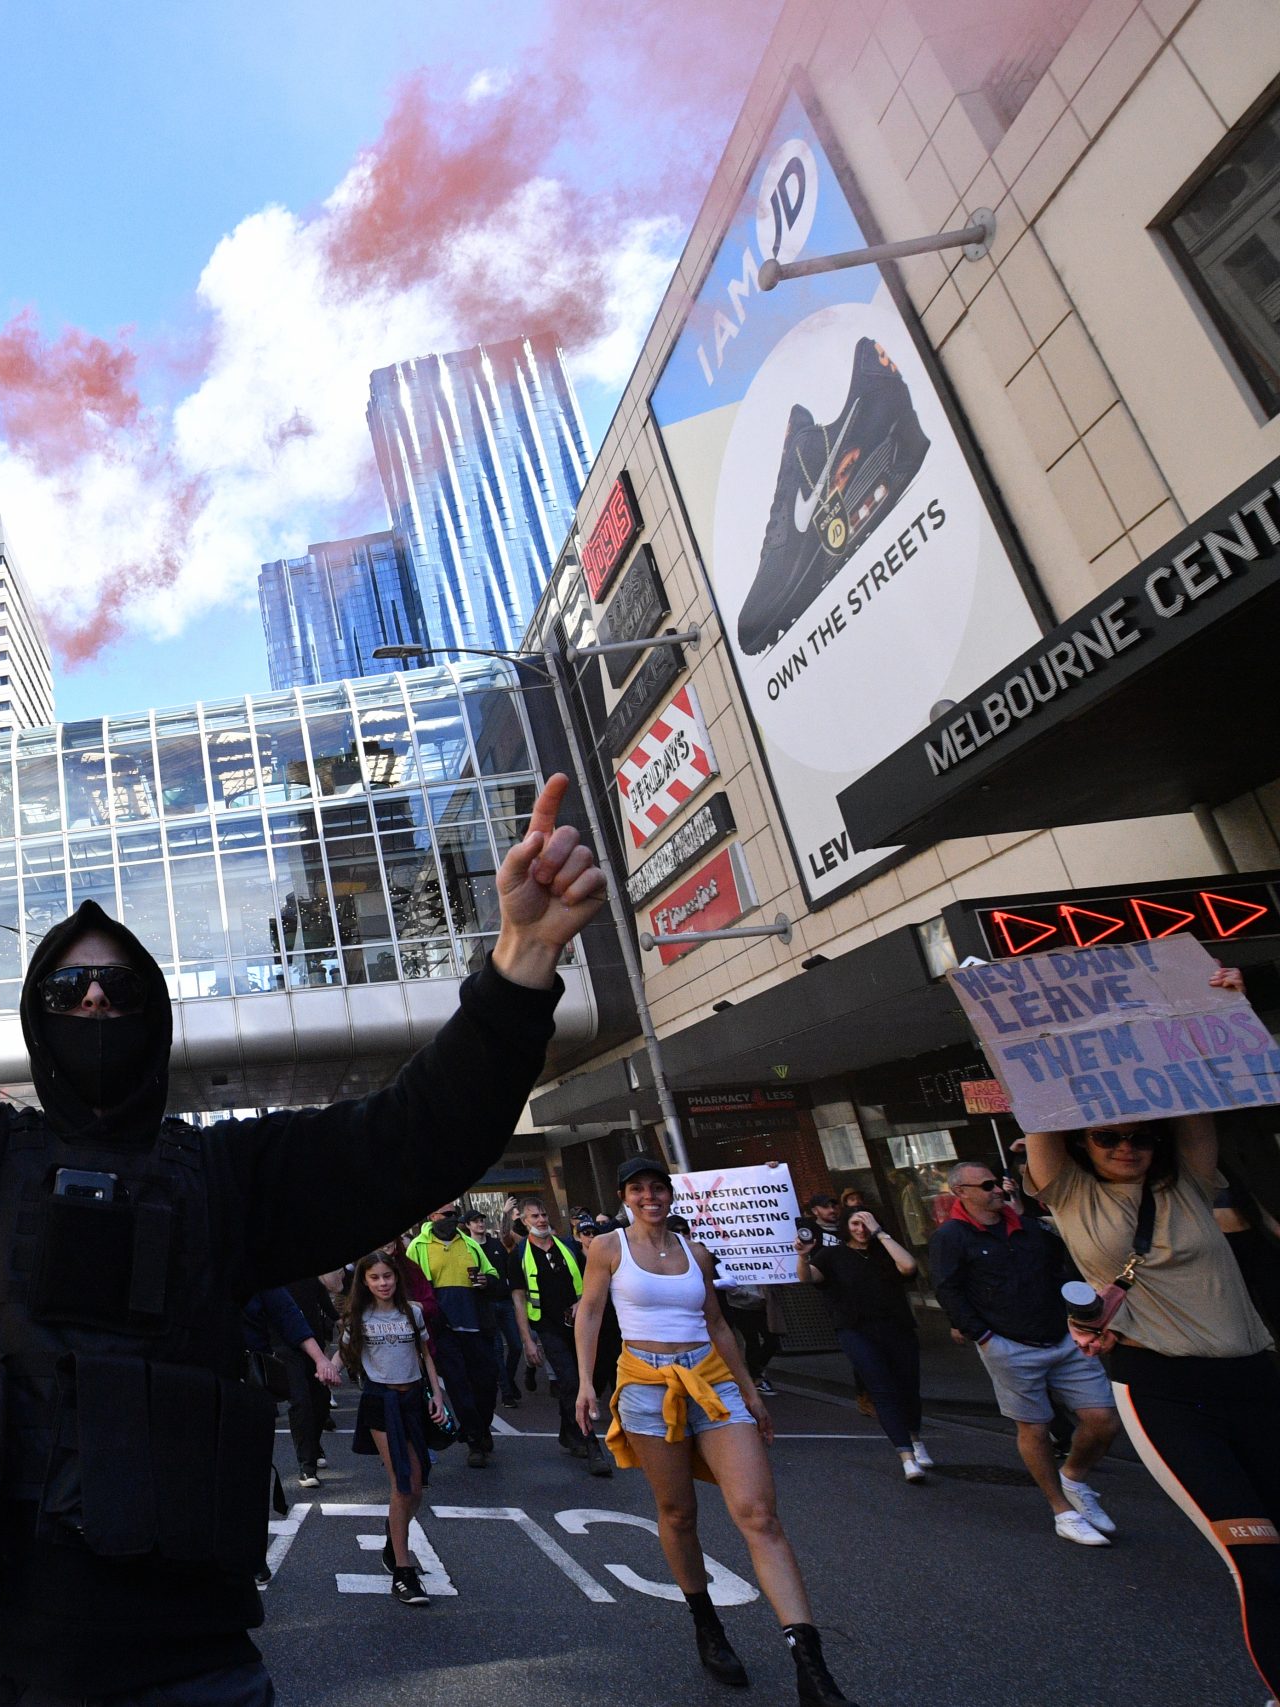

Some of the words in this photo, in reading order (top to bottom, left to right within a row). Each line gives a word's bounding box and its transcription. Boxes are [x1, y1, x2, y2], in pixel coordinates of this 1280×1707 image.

[770, 156, 806, 260] JD
[767, 646, 809, 702] OWN
[807, 604, 848, 655] THE
[847, 498, 947, 616] STREETS
[924, 597, 1141, 777] MELBOURNE
[1144, 480, 1280, 620] CENT
[808, 831, 850, 879] LEV
[952, 958, 1043, 1001] HEY!
[1047, 941, 1158, 980] DAN!
[980, 974, 1148, 1034] LEAVE
[1002, 1023, 1143, 1083] THEM
[1155, 1012, 1269, 1061] KIDS
[688, 1093, 750, 1105] PHARMACY
[767, 1091, 794, 1101] LESS
[674, 1184, 789, 1202] WNS/RESTRICTIONS
[696, 1199, 779, 1214] VACCINATION
[687, 1212, 790, 1228] RACING/TESTING
[691, 1227, 775, 1241] PROPAGANDA
[713, 1247, 748, 1257] ABOUT
[751, 1245, 795, 1255] HEALTH
[725, 1262, 773, 1272] AGENDA!
[732, 1274, 757, 1282] HOICE
[768, 1273, 786, 1281] PRO
